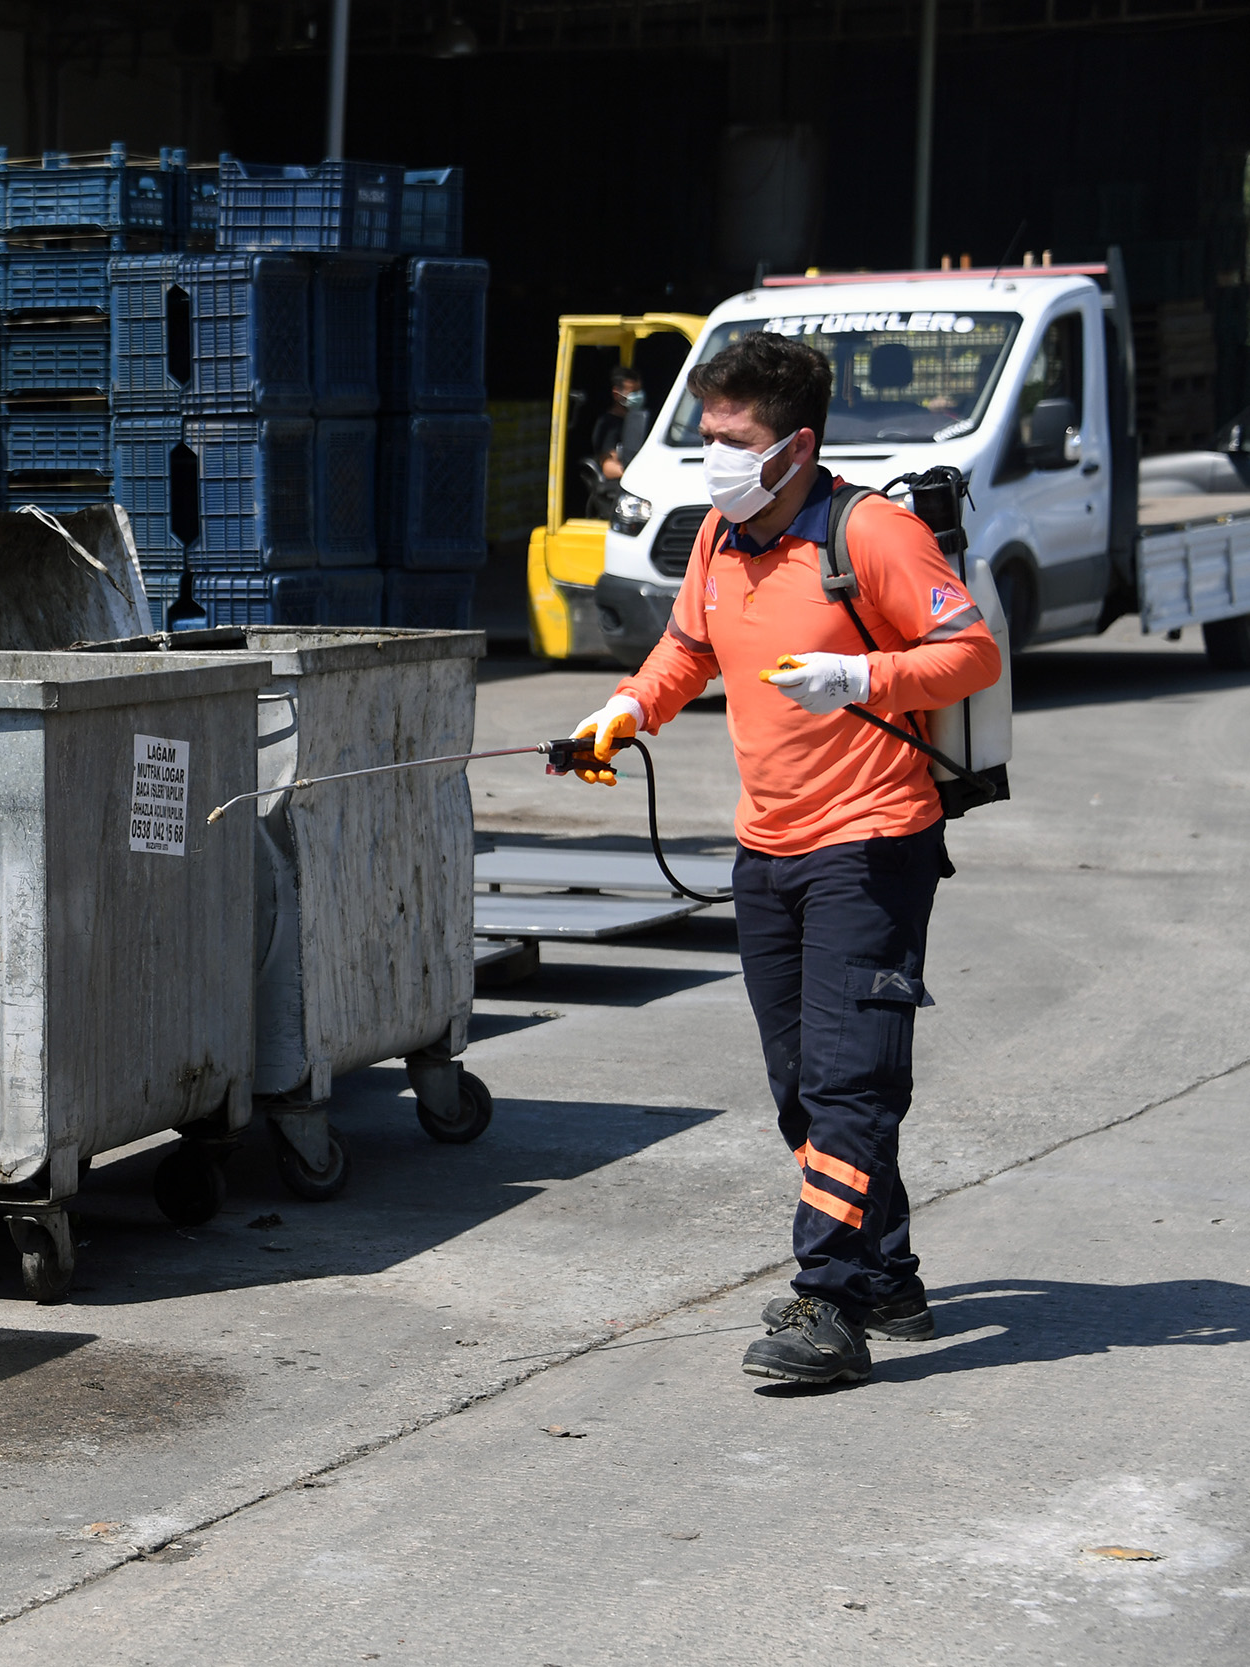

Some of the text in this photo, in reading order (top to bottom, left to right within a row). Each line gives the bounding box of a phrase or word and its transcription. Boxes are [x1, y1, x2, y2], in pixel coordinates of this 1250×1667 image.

[147, 743, 176, 763] LAĞAM
[137, 762, 185, 784] MUTFAK LOGAR
[136, 781, 150, 797] BACA
[131, 819, 151, 840] 0538
[153, 821, 165, 841] 042
[174, 824, 184, 844] 68
